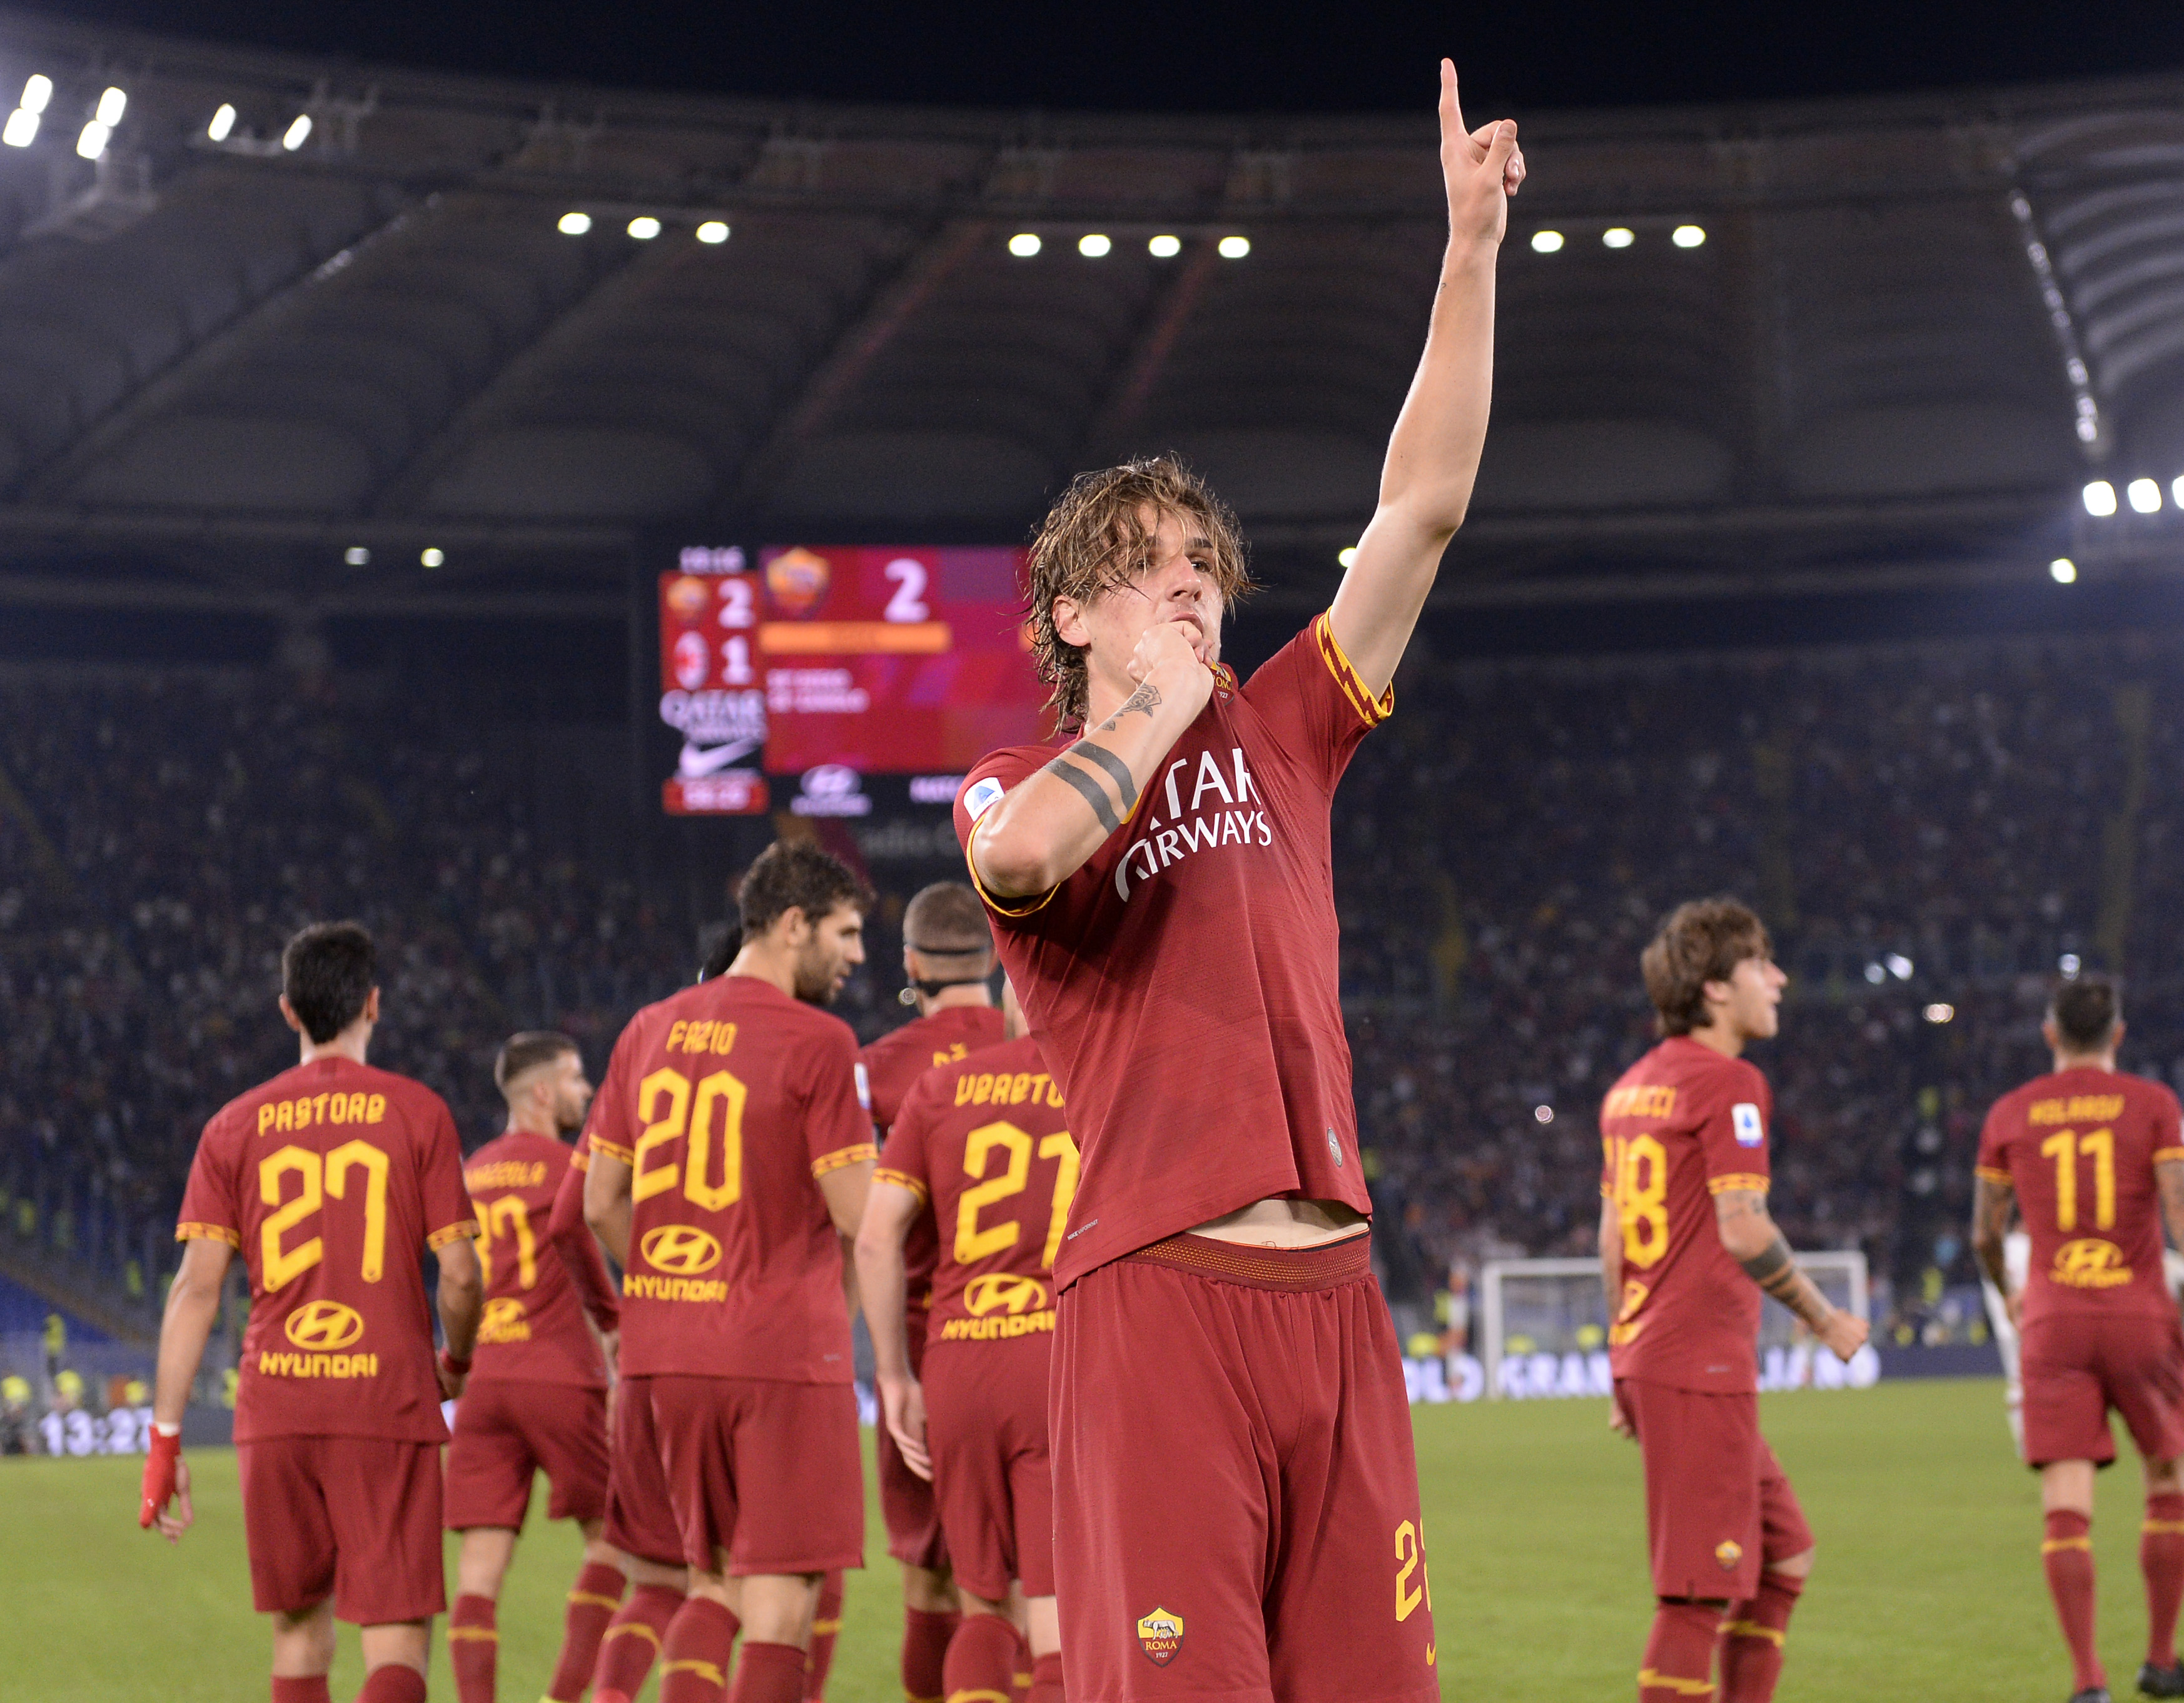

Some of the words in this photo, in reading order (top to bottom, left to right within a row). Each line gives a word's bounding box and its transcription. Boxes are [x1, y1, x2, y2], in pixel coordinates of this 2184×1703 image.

[719, 577, 755, 629] 2
[885, 558, 929, 624] 2
[721, 635, 752, 685] 1
[1150, 747, 1261, 832] TAR
[1135, 811, 1271, 881] IRWAYS
[665, 1019, 738, 1056] FAZIO
[258, 1092, 386, 1137] PASTORE
[954, 1071, 1065, 1108] VERETO
[632, 1067, 747, 1212] 20
[2041, 1128, 2116, 1232] 11
[259, 1139, 390, 1293] 27
[623, 1273, 728, 1303] HYUNDAI
[941, 1310, 1056, 1340] HYUNDAI
[259, 1350, 378, 1378] HYUNDAI
[1395, 1518, 1431, 1622] 2
[1145, 1640, 1177, 1650] ROMA
